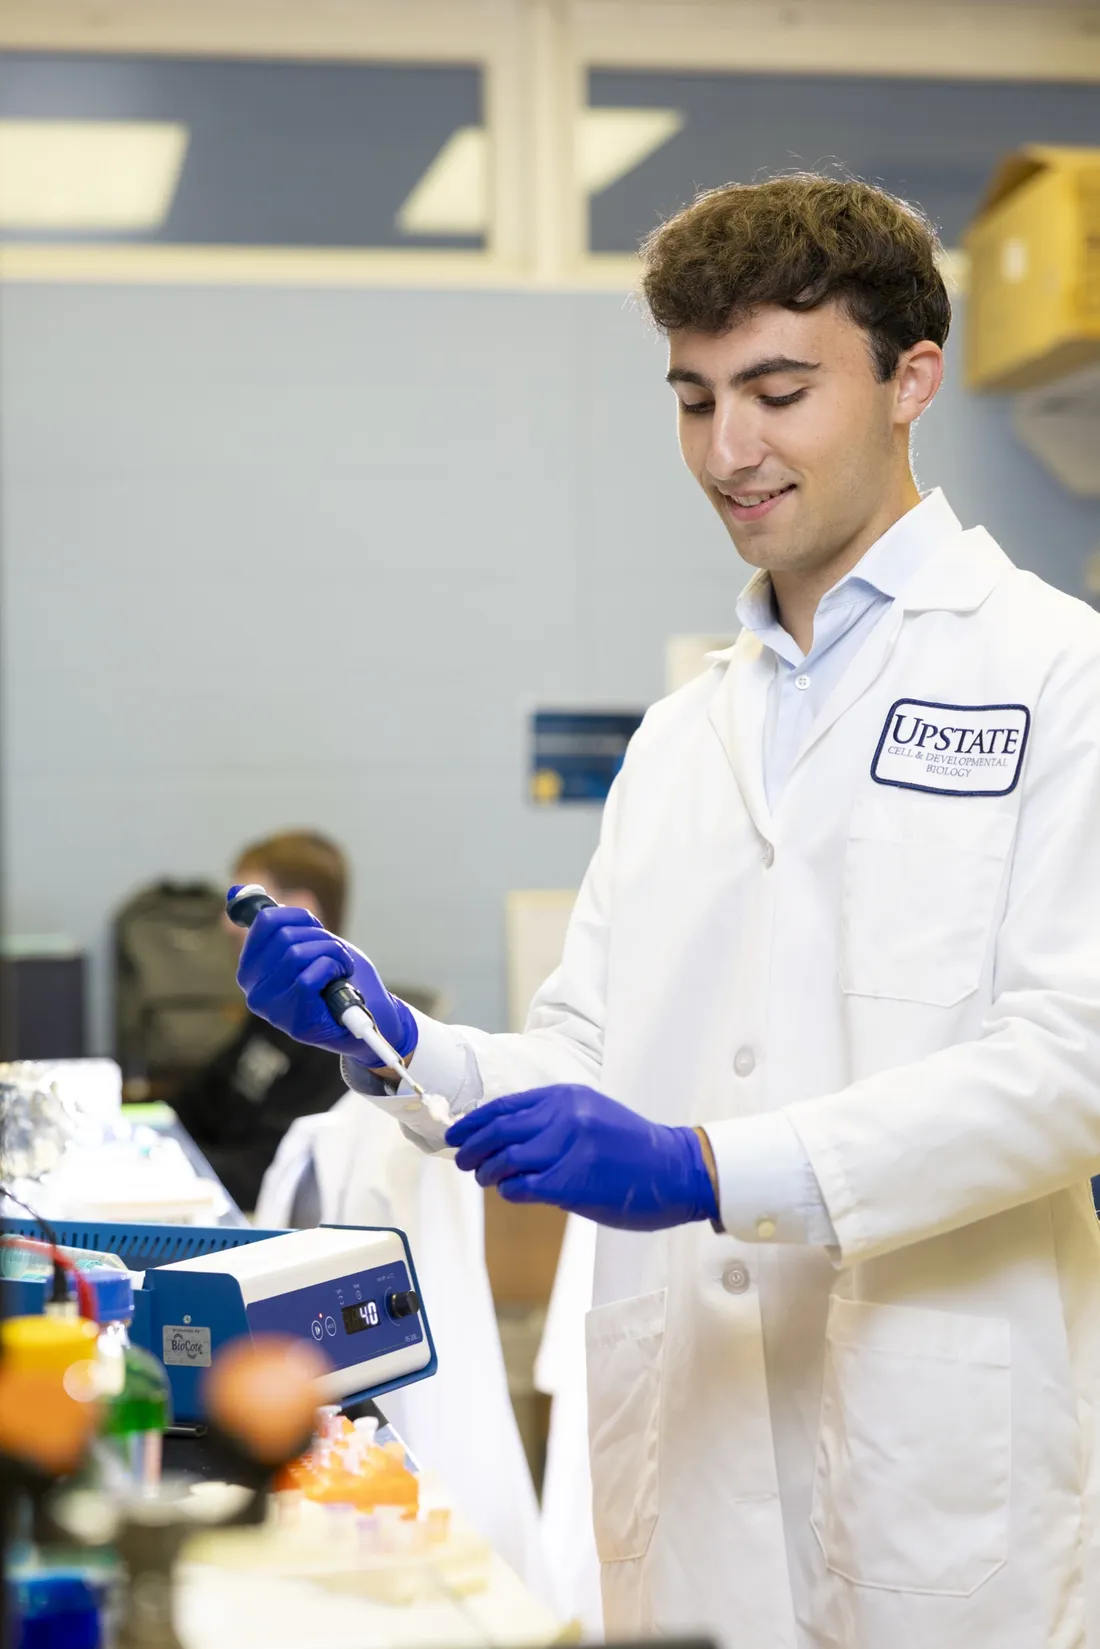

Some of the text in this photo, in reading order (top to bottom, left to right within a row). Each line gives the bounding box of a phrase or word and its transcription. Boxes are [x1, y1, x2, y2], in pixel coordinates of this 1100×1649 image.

[893, 714, 1019, 754] UPSTATE
[887, 746, 1008, 767] CELL & DEVELOPMENTAL
[926, 765, 972, 777] BIOLOGY
[359, 1301, 379, 1325] 40
[171, 1340, 203, 1352] BioCote
